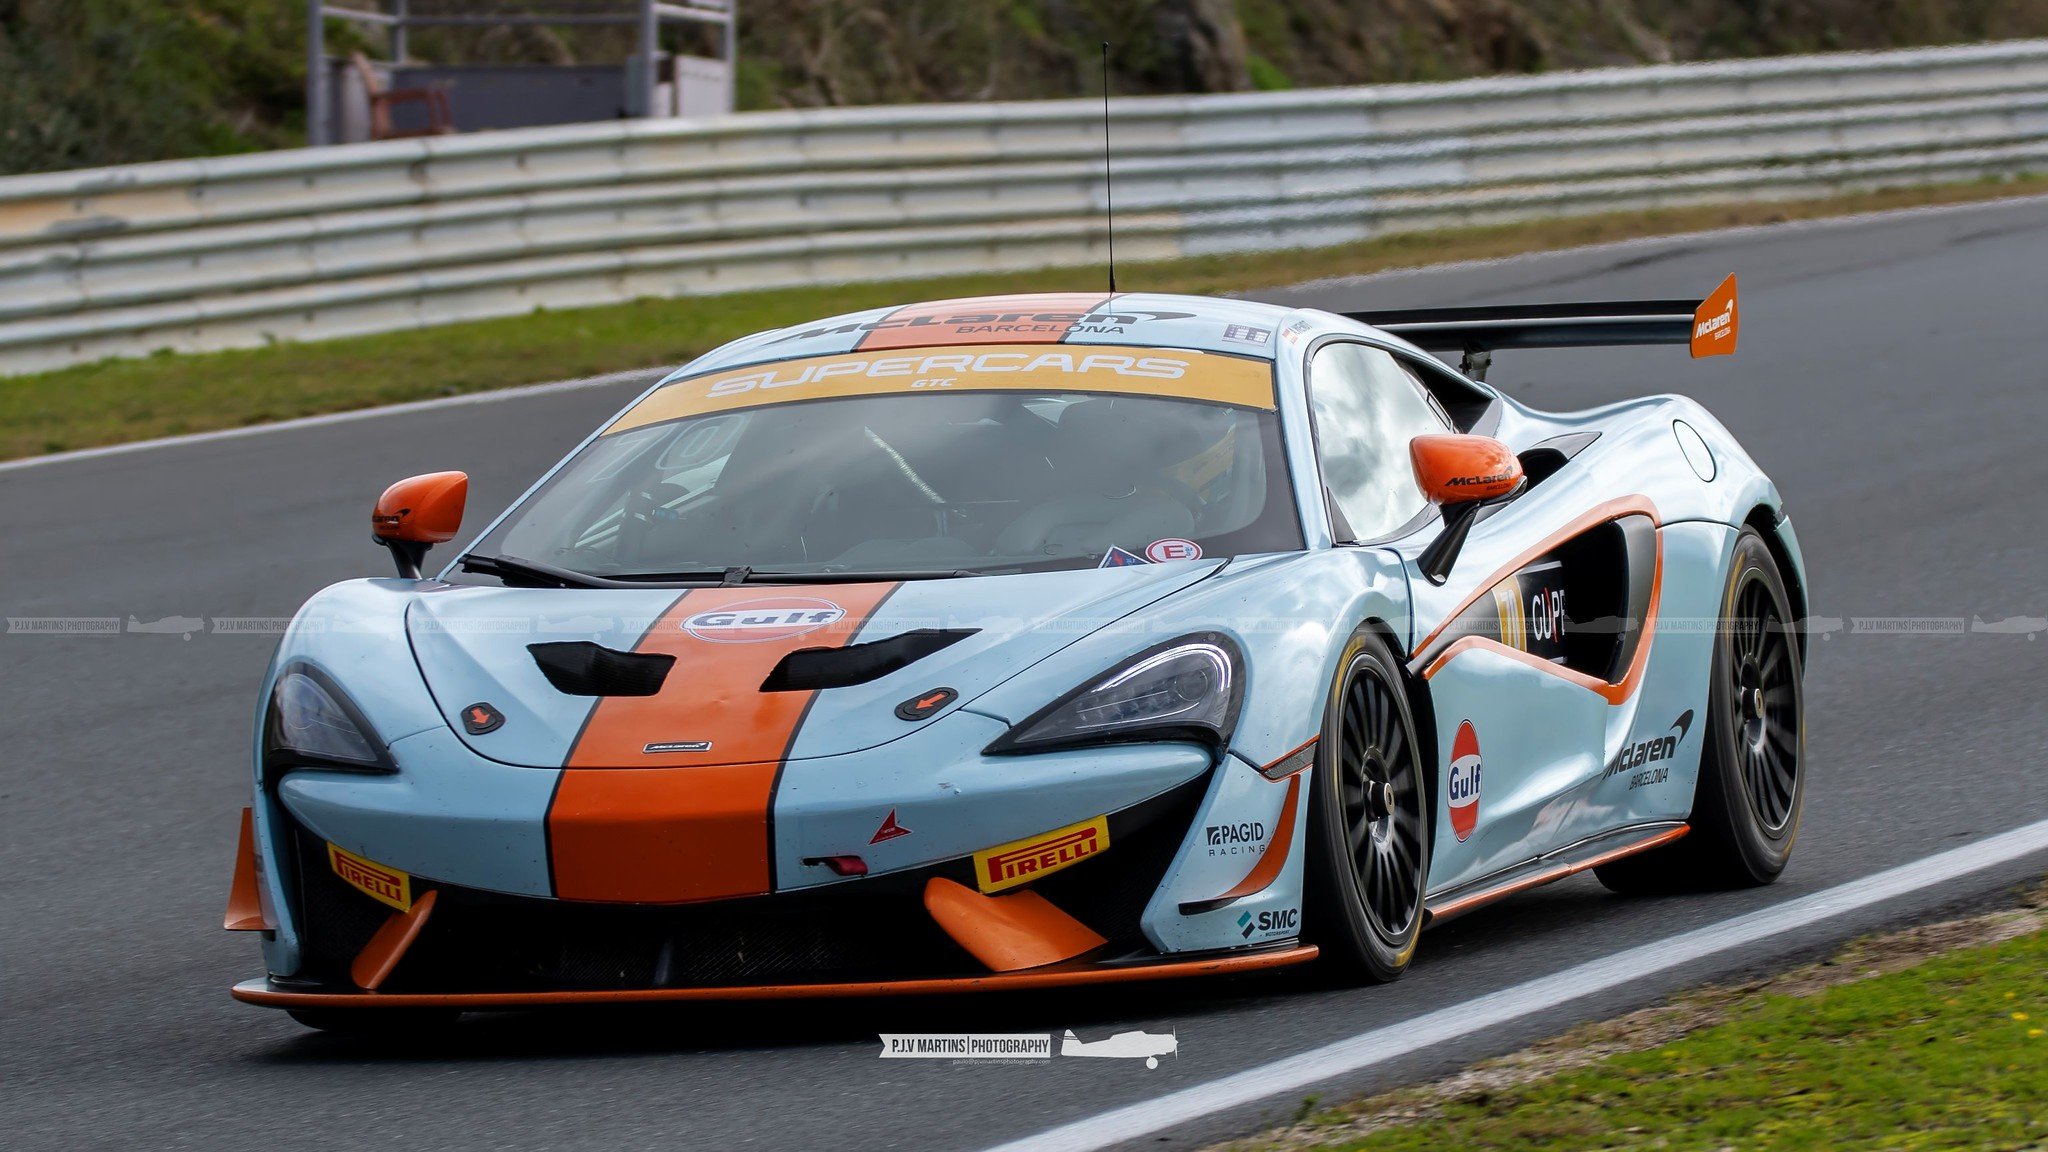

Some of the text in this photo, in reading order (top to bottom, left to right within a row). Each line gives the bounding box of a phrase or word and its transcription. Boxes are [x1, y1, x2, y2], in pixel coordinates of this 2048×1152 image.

[760, 313, 1138, 345] McLaren
[955, 324, 1125, 334] BARCELONA
[705, 354, 1190, 398] SUPERCARS
[911, 378, 957, 388] GTC
[1445, 474, 1511, 487] McLaren
[692, 611, 837, 626] Gulf
[1602, 735, 1676, 780] McLaren
[1450, 763, 1481, 800] Gulf
[1629, 768, 1669, 790] BARCELONA
[1222, 822, 1264, 844] PAGID
[987, 827, 1097, 883] PIRELLI
[1209, 845, 1266, 856] RACING
[333, 850, 402, 903] PIRELLI
[1258, 908, 1297, 930] SMC
